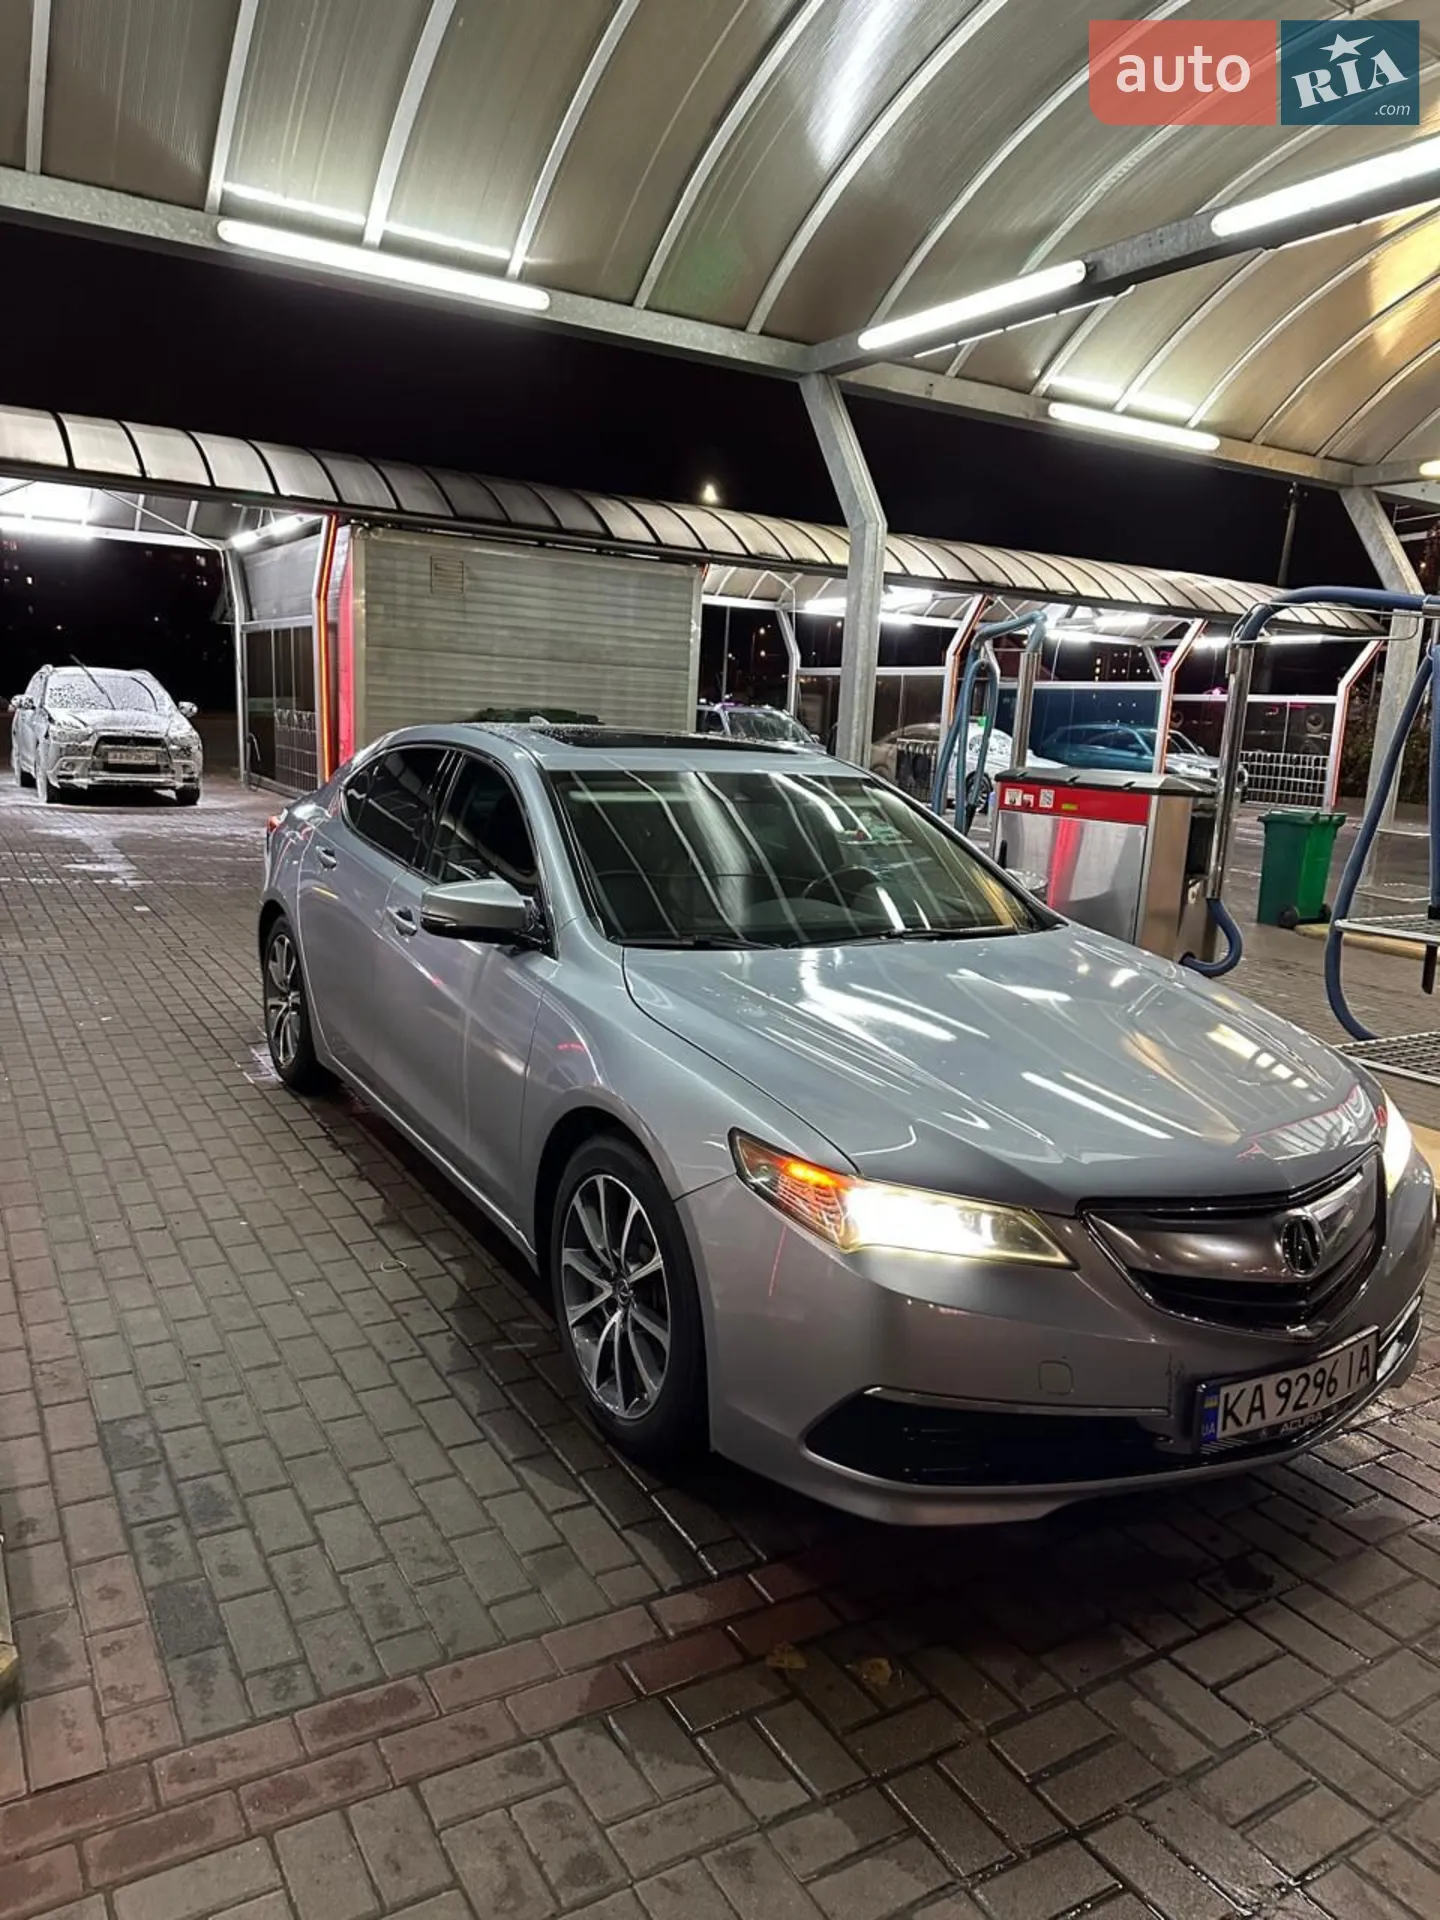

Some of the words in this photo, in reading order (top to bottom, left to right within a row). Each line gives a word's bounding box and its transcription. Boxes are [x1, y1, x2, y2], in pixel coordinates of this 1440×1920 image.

[1221, 1383, 1266, 1432] KA
[1276, 1359, 1339, 1417] 9296
[1347, 1344, 1371, 1389] IA
[1202, 1422, 1216, 1438] UA
[1280, 1411, 1323, 1435] ACURA
